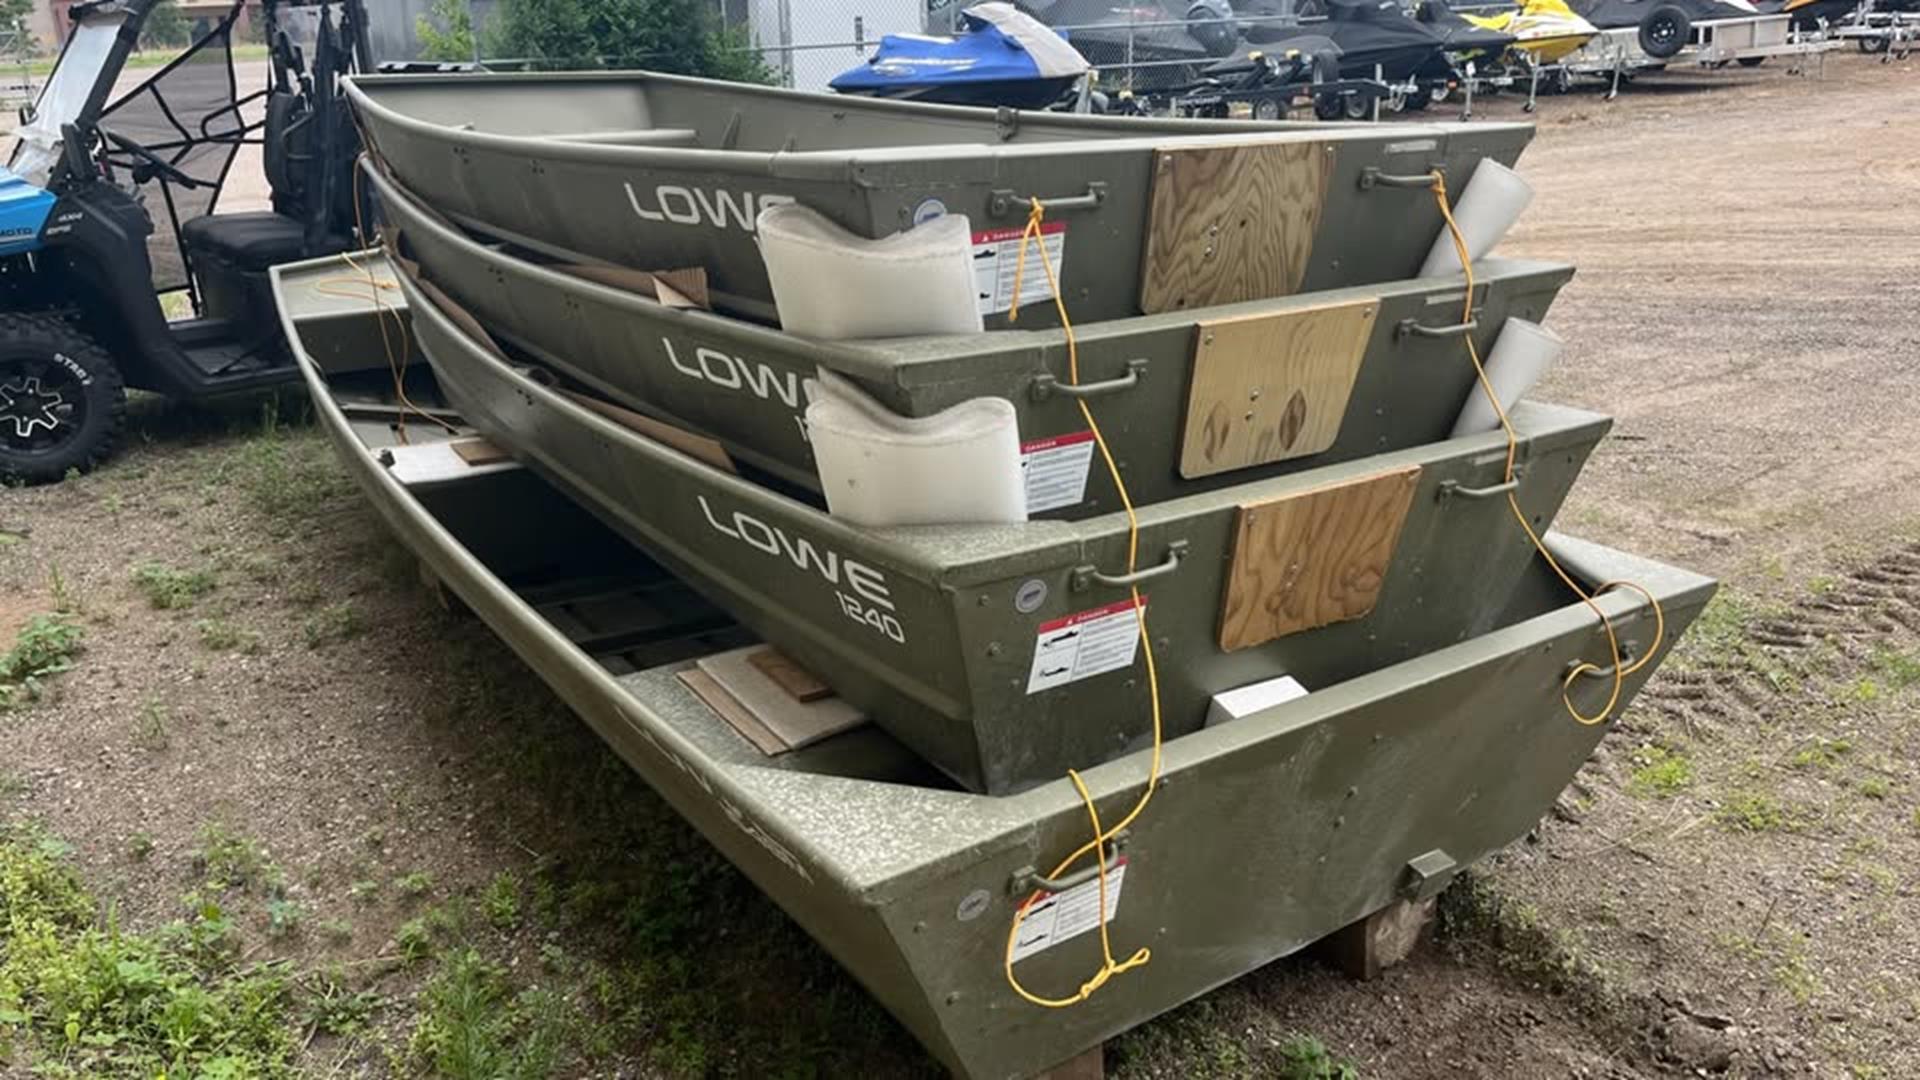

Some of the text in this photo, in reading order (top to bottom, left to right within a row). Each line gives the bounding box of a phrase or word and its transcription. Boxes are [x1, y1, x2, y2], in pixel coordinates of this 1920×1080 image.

[661, 336, 815, 408] LOW
[697, 495, 896, 612] LOWE
[835, 590, 905, 643] 1240
